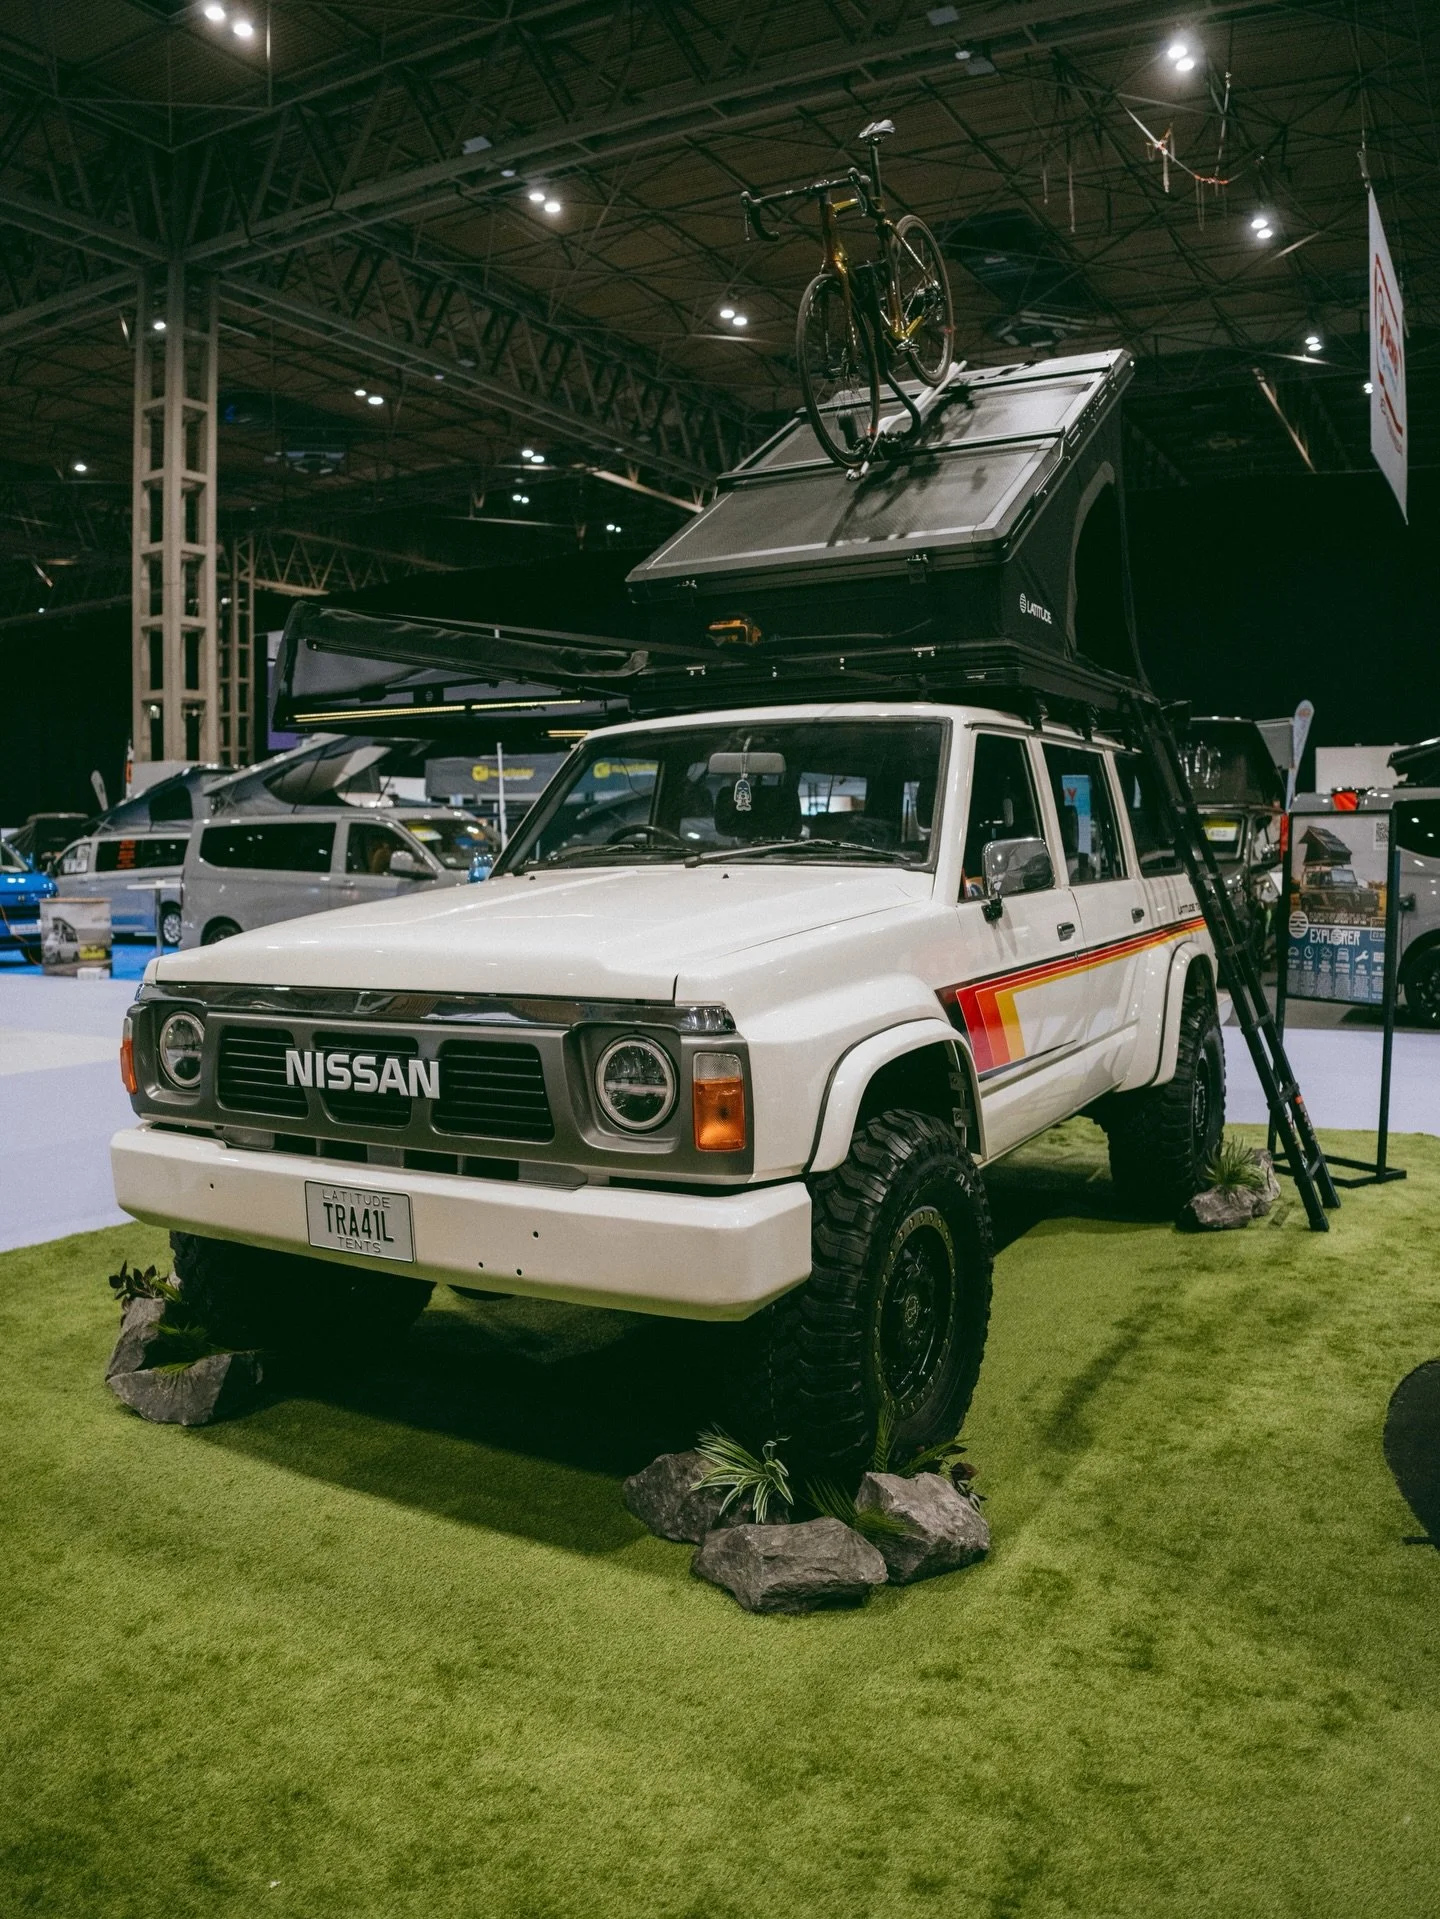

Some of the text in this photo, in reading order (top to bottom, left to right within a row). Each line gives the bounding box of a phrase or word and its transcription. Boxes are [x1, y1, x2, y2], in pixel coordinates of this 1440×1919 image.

[1027, 600, 1052, 625] LATITUDE
[1309, 928, 1361, 946] EXPLORER
[285, 1050, 440, 1099] NISSAN
[322, 1189, 391, 1209] LATITUDE
[323, 1202, 394, 1242] TRA41L
[337, 1236, 381, 1253] TENTS
